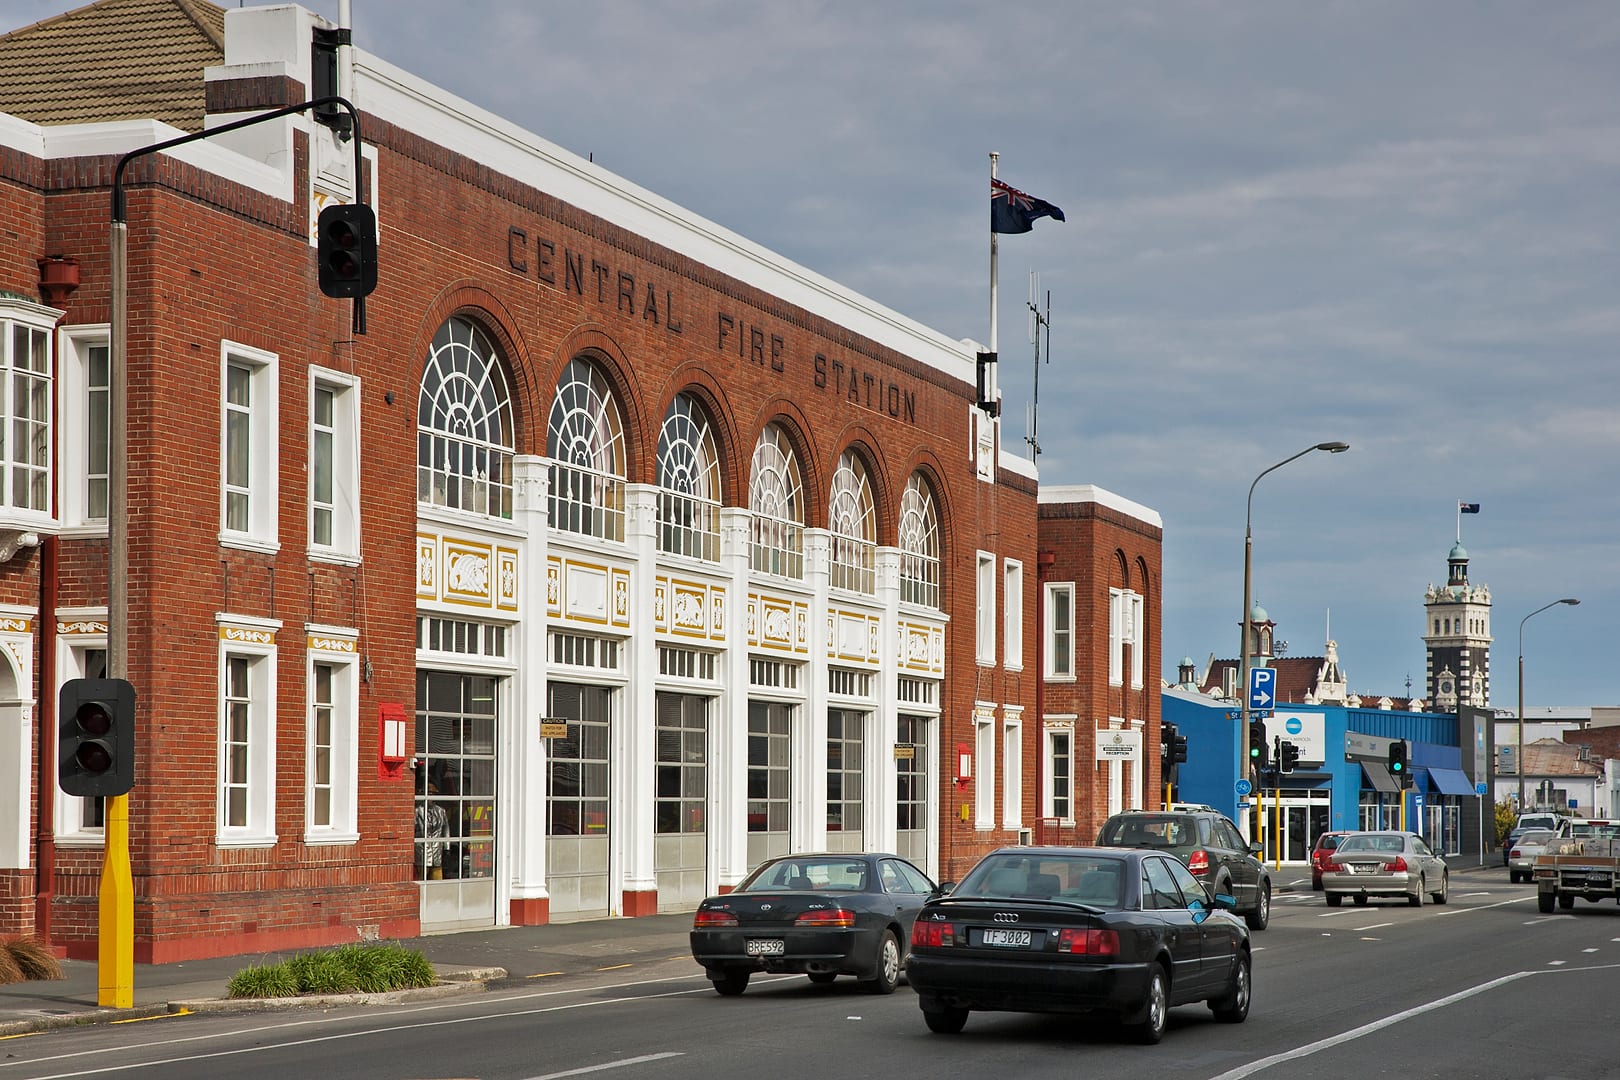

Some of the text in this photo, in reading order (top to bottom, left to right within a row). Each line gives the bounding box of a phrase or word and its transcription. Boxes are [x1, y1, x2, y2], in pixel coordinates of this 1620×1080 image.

[508, 225, 916, 424] CENTRAL FIRE STATION
[1255, 671, 1271, 689] P
[985, 929, 1030, 945] TF3002
[748, 941, 784, 953] BRE592
